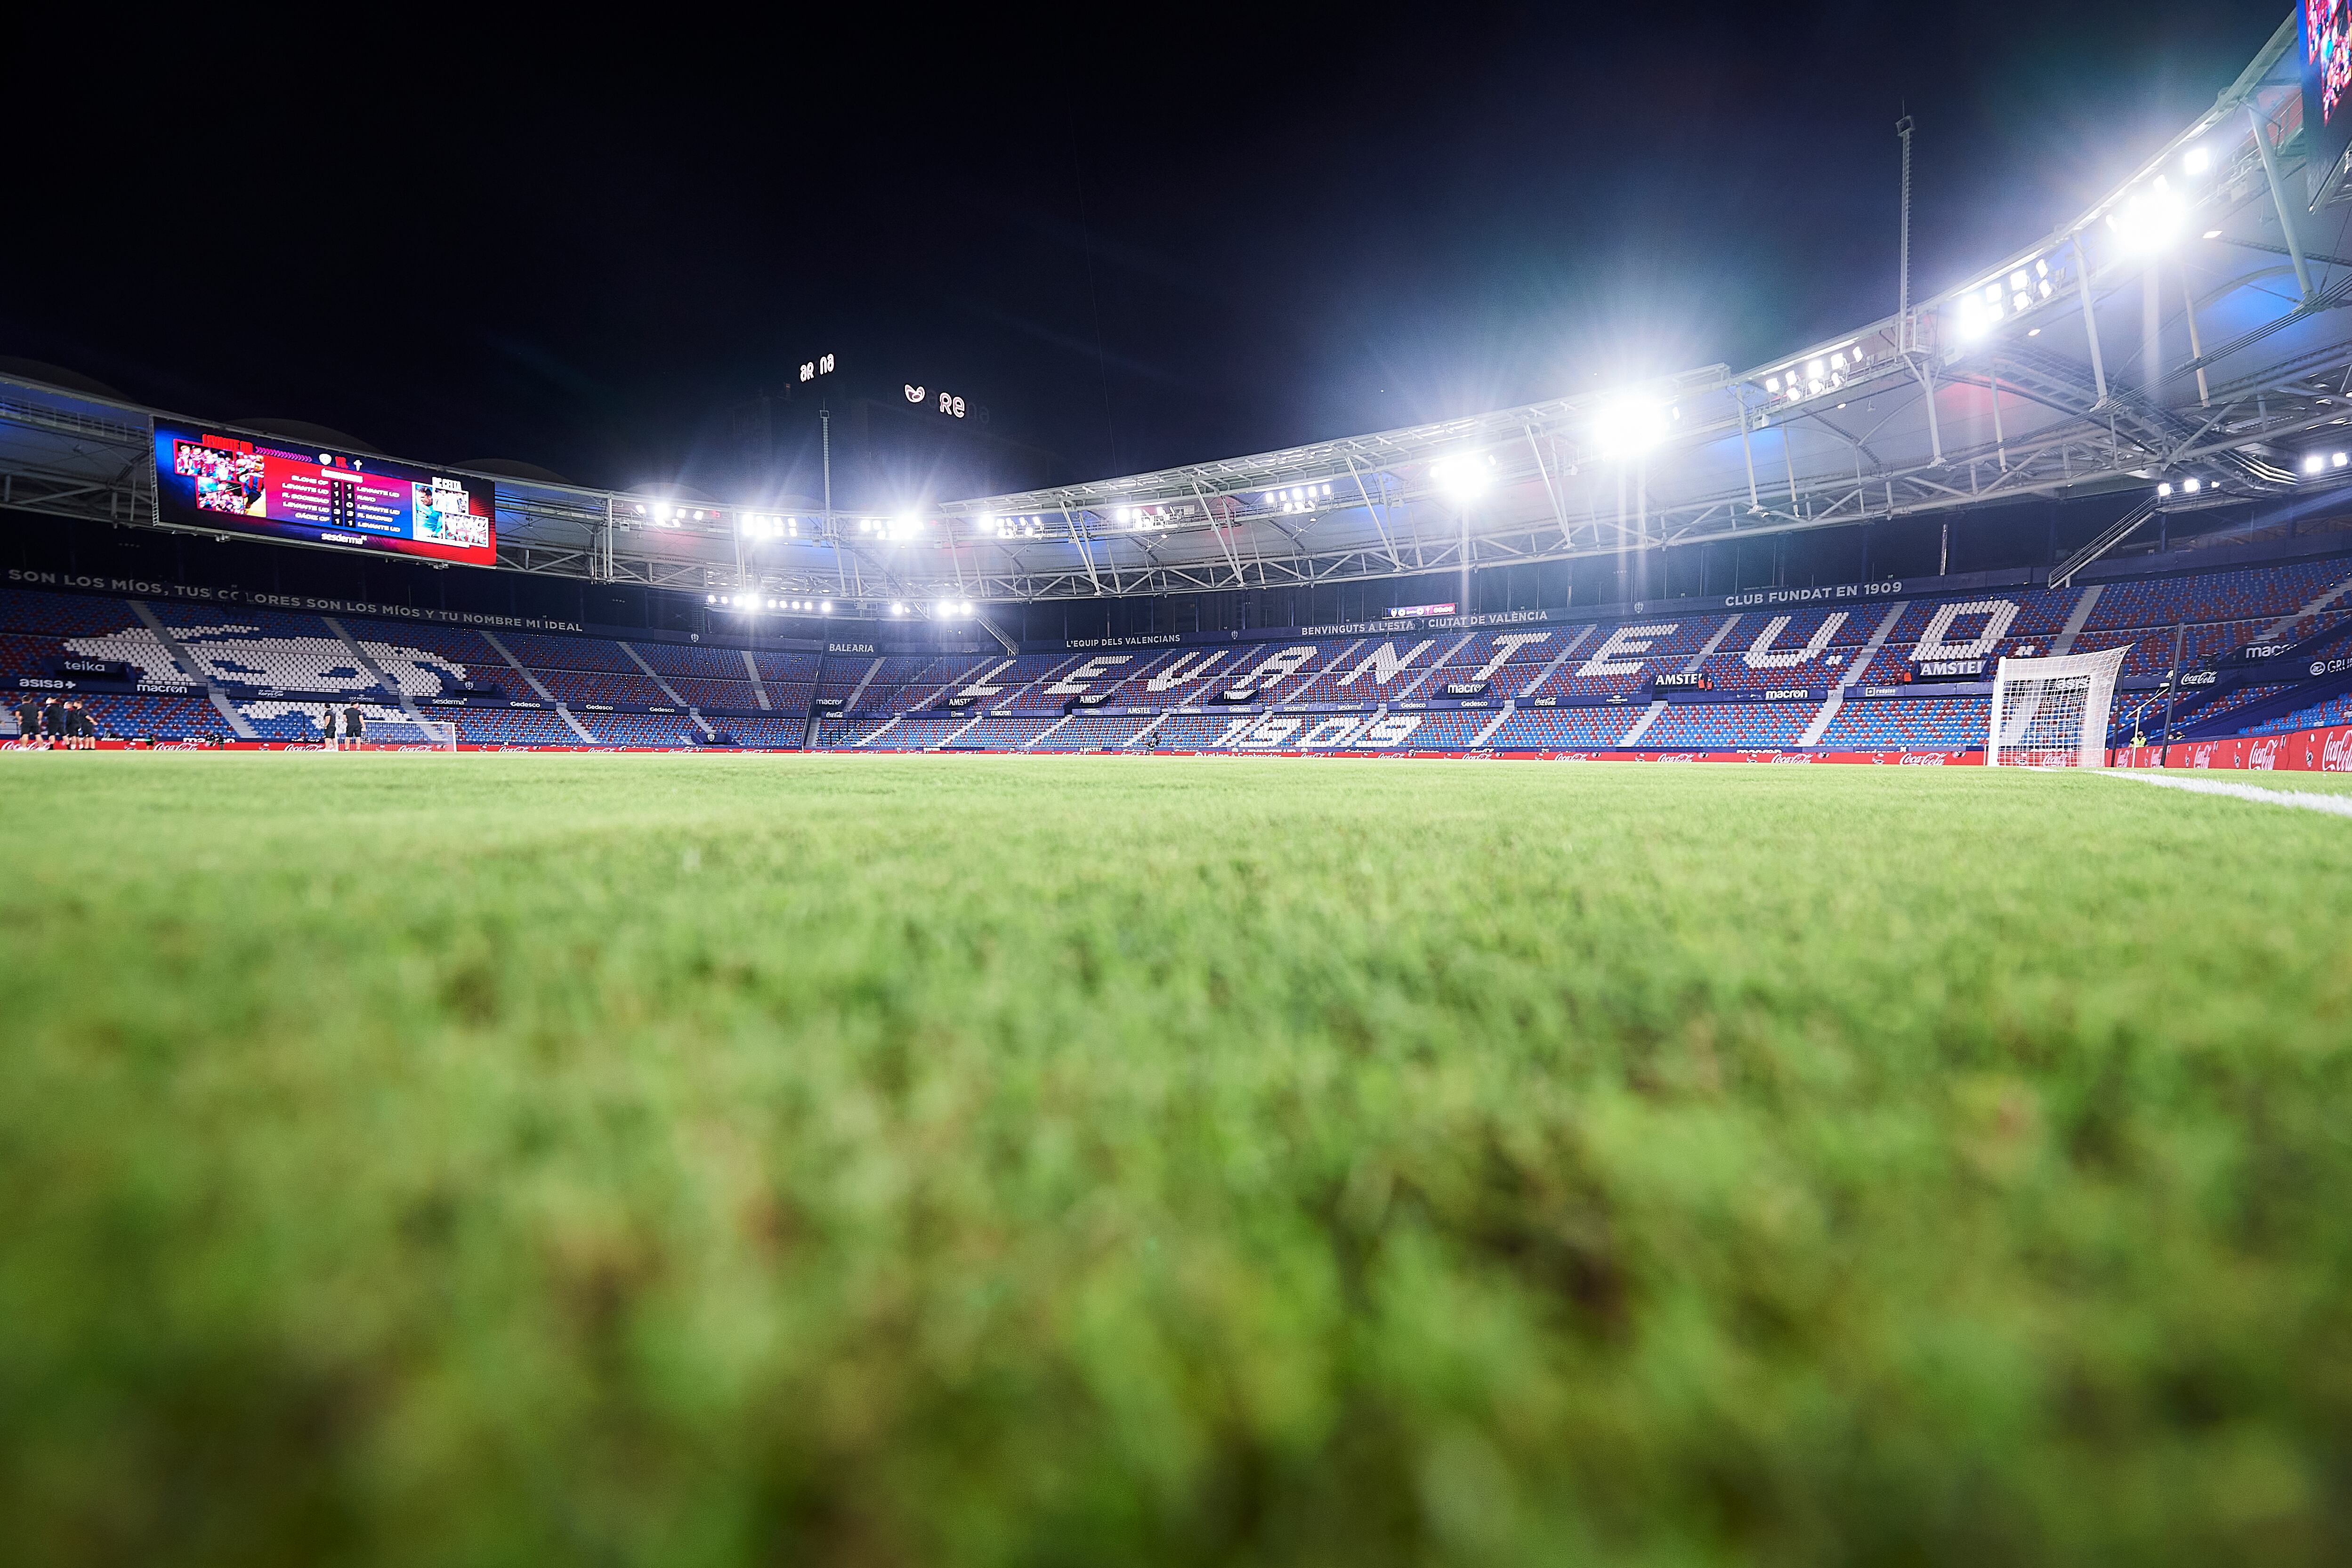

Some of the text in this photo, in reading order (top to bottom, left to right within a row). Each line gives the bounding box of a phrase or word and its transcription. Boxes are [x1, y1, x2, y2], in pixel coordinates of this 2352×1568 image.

[1725, 581, 1903, 607] CLUB FUNDAT EN 1909
[8, 569, 56, 583] SON
[64, 574, 105, 588] LOS
[174, 585, 211, 598] TUS
[306, 598, 340, 610] SON
[347, 602, 377, 613] LOS
[382, 605, 420, 617] MÍOS
[425, 610, 434, 618] Y
[439, 612, 458, 621] TU
[463, 614, 522, 627] NOMBRE
[526, 620, 540, 628] MI
[545, 621, 583, 632] IDEAL
[1301, 623, 1366, 636] BENVINGUTS
[1428, 617, 1467, 628] CIUTAT
[1471, 614, 1485, 625] DE
[1488, 610, 1548, 623] VALÈNCIA
[1067, 634, 1181, 648] L'EQUIP DELS VALENCIANS
[829, 643, 874, 653] BALEARIA
[64, 660, 105, 671] teika
[19, 678, 64, 689] asisa
[2181, 671, 2219, 685] Coca-Cola
[137, 684, 188, 694] macron
[1766, 690, 1808, 699] macron
[1535, 697, 1557, 706] Coca-Cola
[1899, 752, 1948, 765] Coca-Cola
